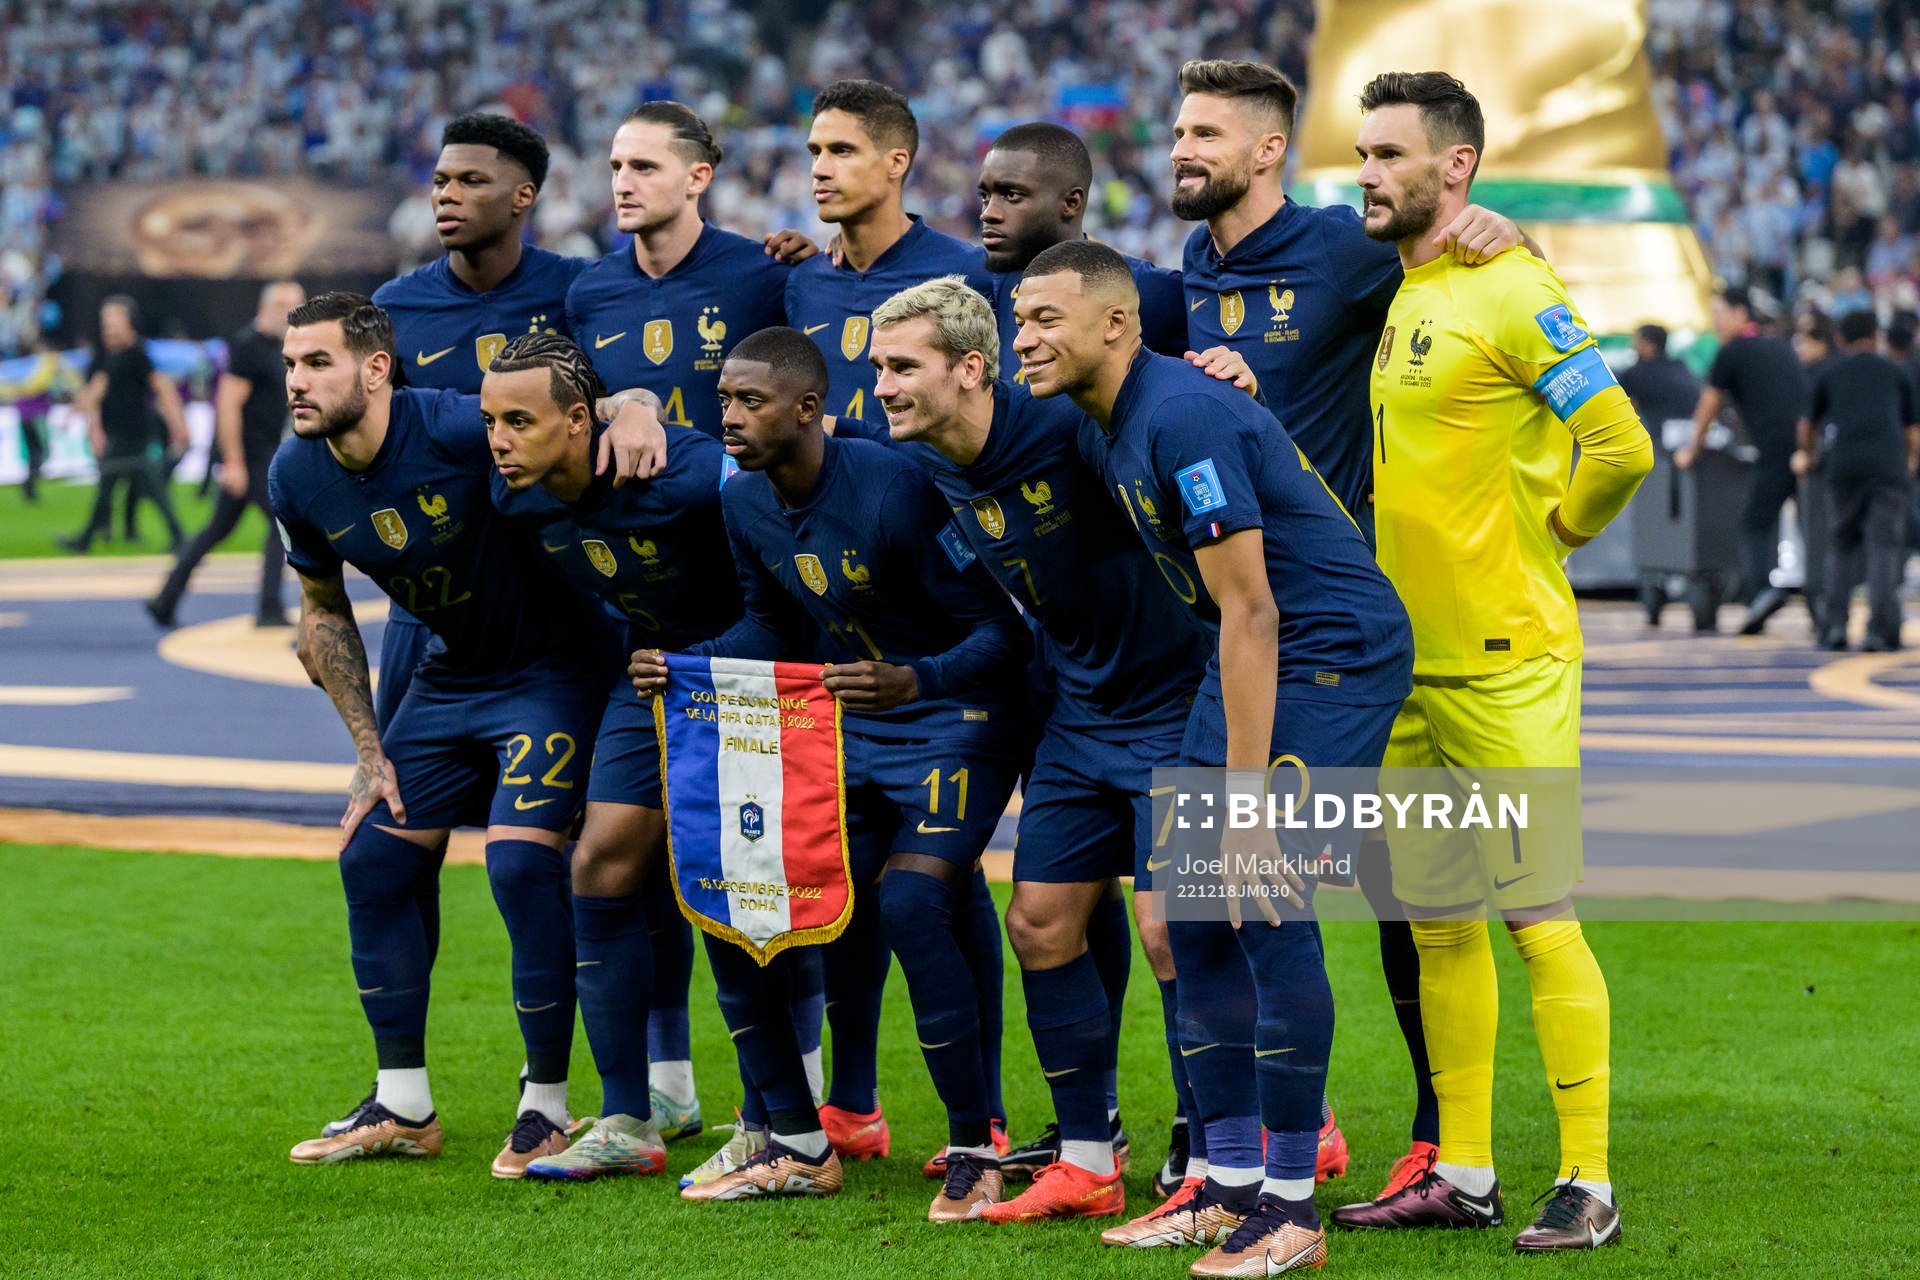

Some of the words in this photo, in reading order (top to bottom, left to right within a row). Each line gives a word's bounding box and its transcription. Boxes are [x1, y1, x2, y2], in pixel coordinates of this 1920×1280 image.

[1550, 371, 1583, 401] UNITES
[1002, 557, 1041, 606] 7
[691, 690, 738, 706] COUPE
[738, 695, 758, 708] DU
[758, 695, 808, 711] MONDE
[685, 707, 702, 719] DE
[702, 708, 717, 722] LA
[719, 711, 741, 724] FIFA
[744, 713, 785, 728] QATAR
[786, 715, 815, 729] 2022
[723, 735, 779, 755] FINALE
[502, 732, 576, 789] 22
[921, 767, 969, 821] 11
[1149, 785, 1177, 847] 7
[712, 878, 785, 897] DECEMBRE
[787, 886, 823, 899] 2022
[739, 898, 779, 913] DOHA
